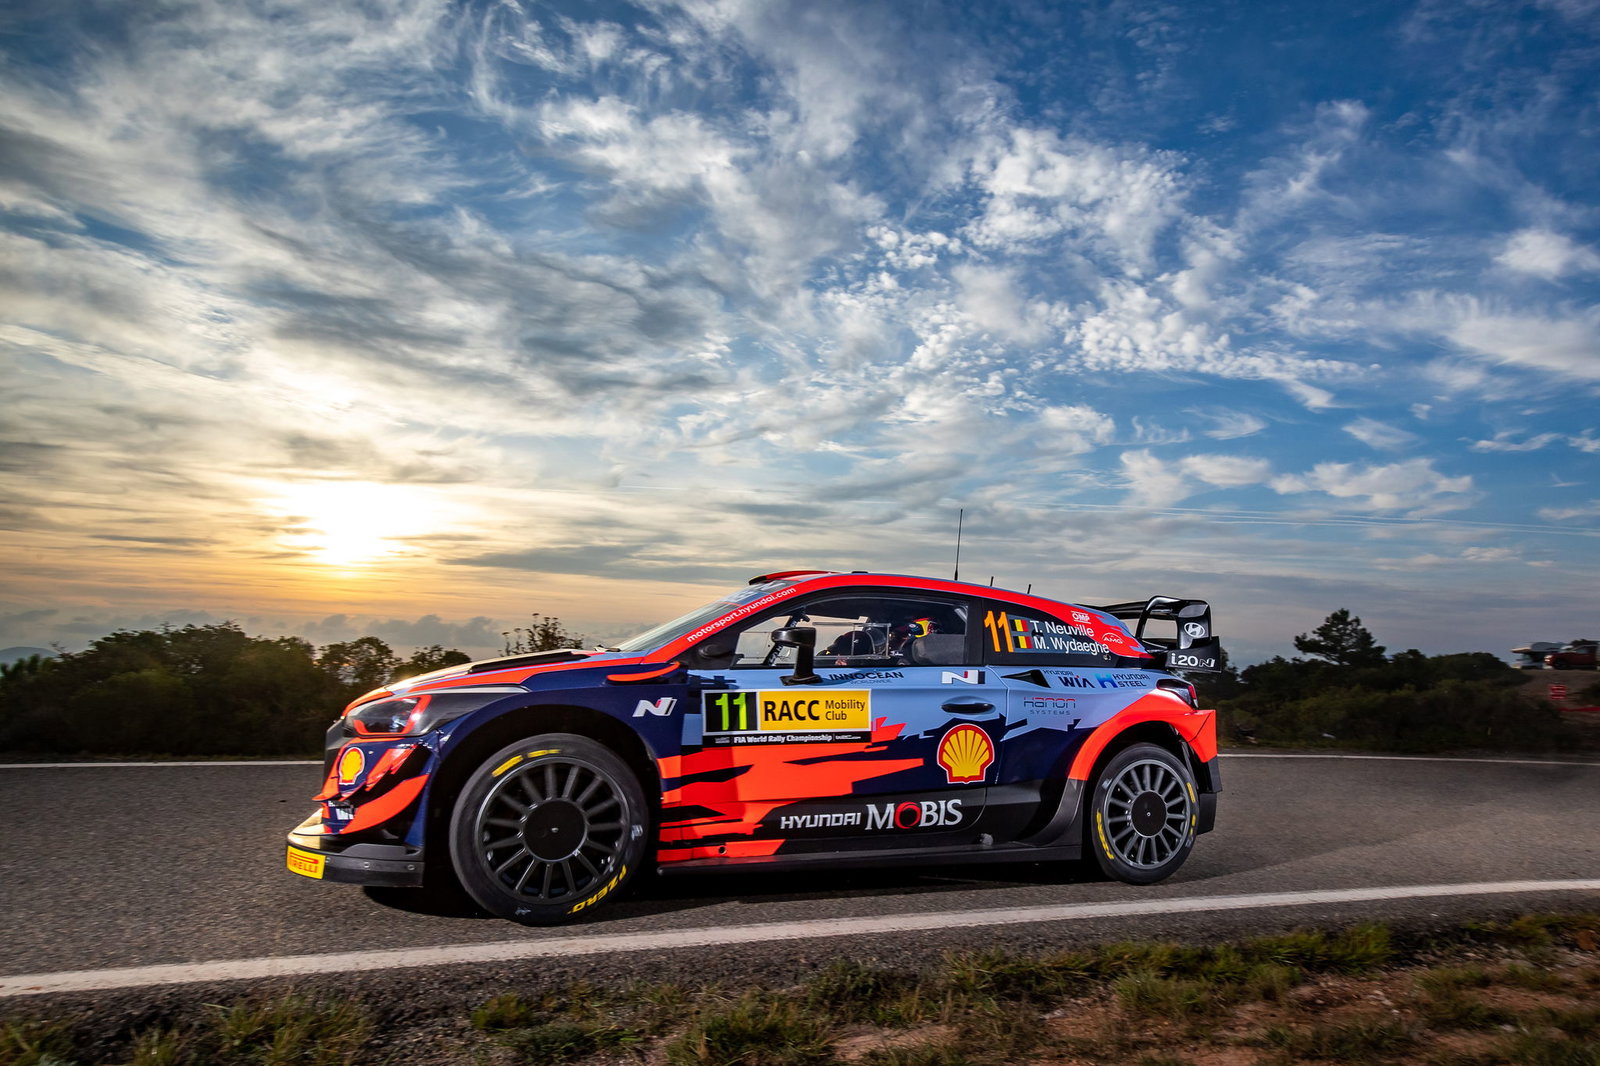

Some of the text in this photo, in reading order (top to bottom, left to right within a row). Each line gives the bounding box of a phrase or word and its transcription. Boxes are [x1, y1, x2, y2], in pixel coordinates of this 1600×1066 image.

[686, 587, 796, 642] motorsport.hyundai.com
[984, 610, 1014, 652] 11
[1030, 620, 1095, 637] T. Neuville
[1034, 636, 1110, 655] M. Wydaeghe
[829, 671, 904, 681] INNOCEAN
[715, 692, 748, 730] 11
[763, 699, 866, 721] RACC Mobility
[825, 710, 848, 721] Club
[733, 736, 747, 744] FIA
[747, 735, 767, 743] World
[768, 735, 786, 744] Rally
[787, 734, 832, 743] Championship
[780, 799, 963, 831] HYUNDAI MOBIS
[289, 857, 319, 874] RELLI
